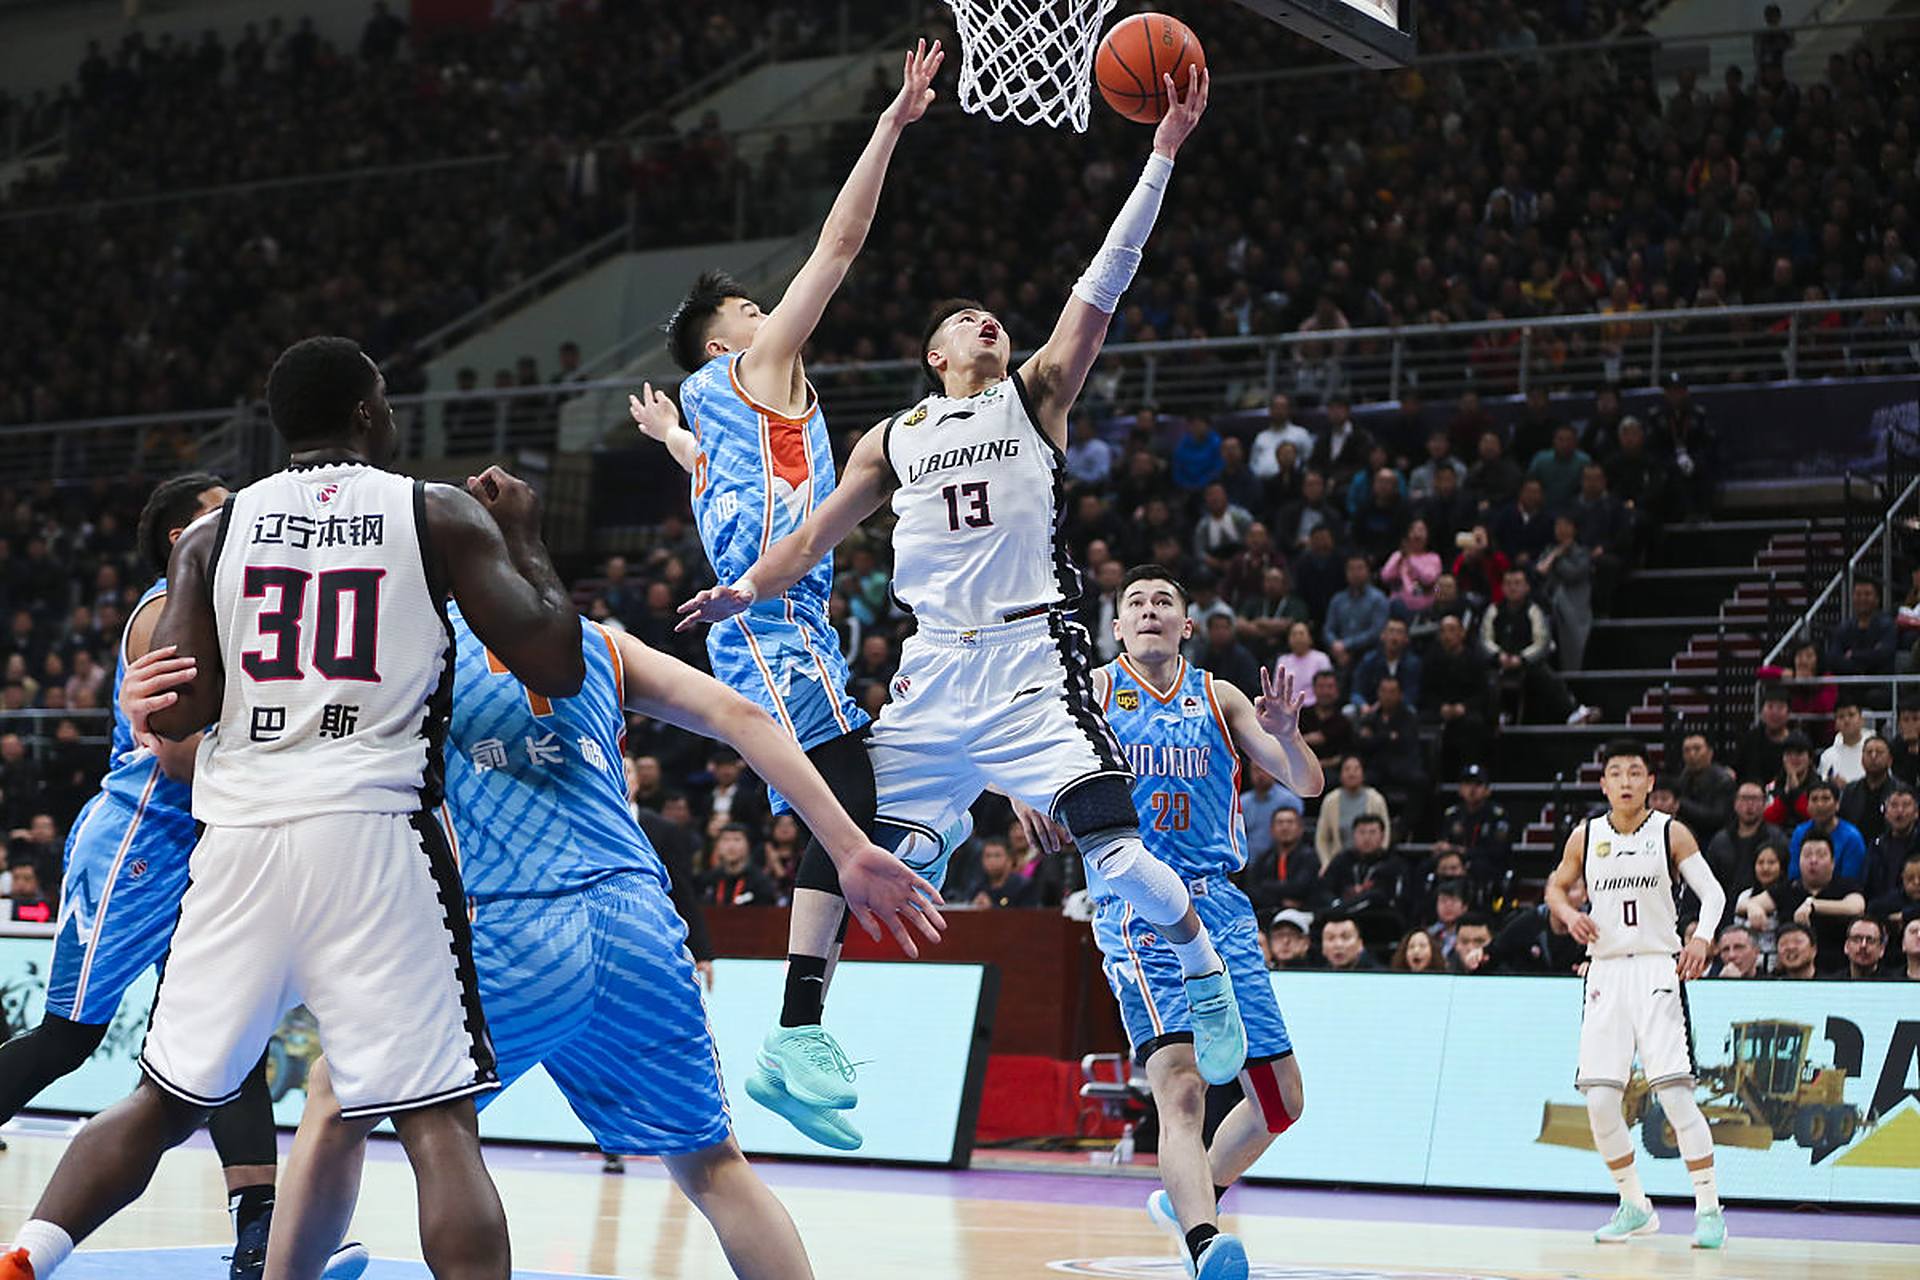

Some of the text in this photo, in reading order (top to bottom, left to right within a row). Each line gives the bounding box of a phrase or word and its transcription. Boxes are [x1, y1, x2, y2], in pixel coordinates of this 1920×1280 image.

[908, 439, 1020, 483] LIAONING
[942, 480, 994, 532] 13
[251, 512, 384, 550] 辽宁本钢
[241, 565, 387, 683] 30
[1116, 693, 1138, 710] ups
[250, 703, 359, 742] 巴斯
[1151, 790, 1192, 832] 23
[1622, 899, 1638, 928] 0
